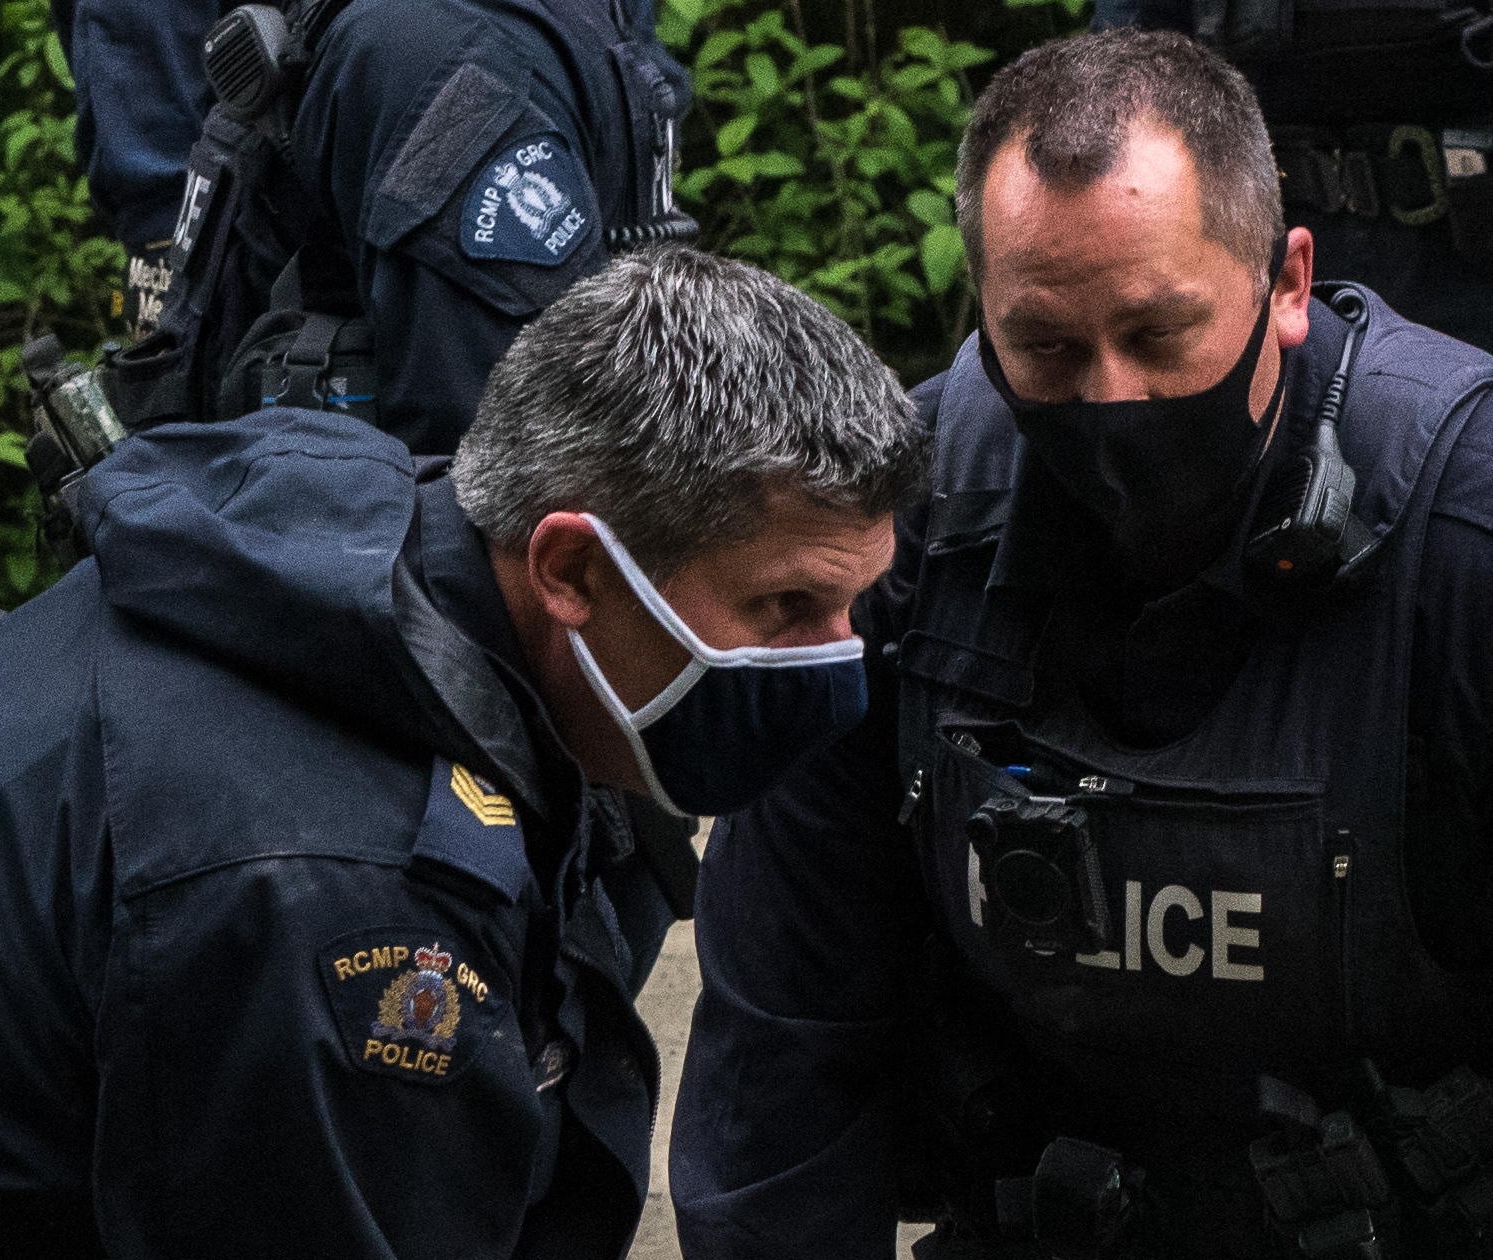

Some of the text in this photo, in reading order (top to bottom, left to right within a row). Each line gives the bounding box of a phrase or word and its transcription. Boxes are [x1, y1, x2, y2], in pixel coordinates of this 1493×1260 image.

[474, 141, 553, 243] RCMP GRC
[543, 207, 586, 256] POLICE
[333, 945, 489, 1003] RCMP GRC
[364, 1038, 452, 1076] POLICE
